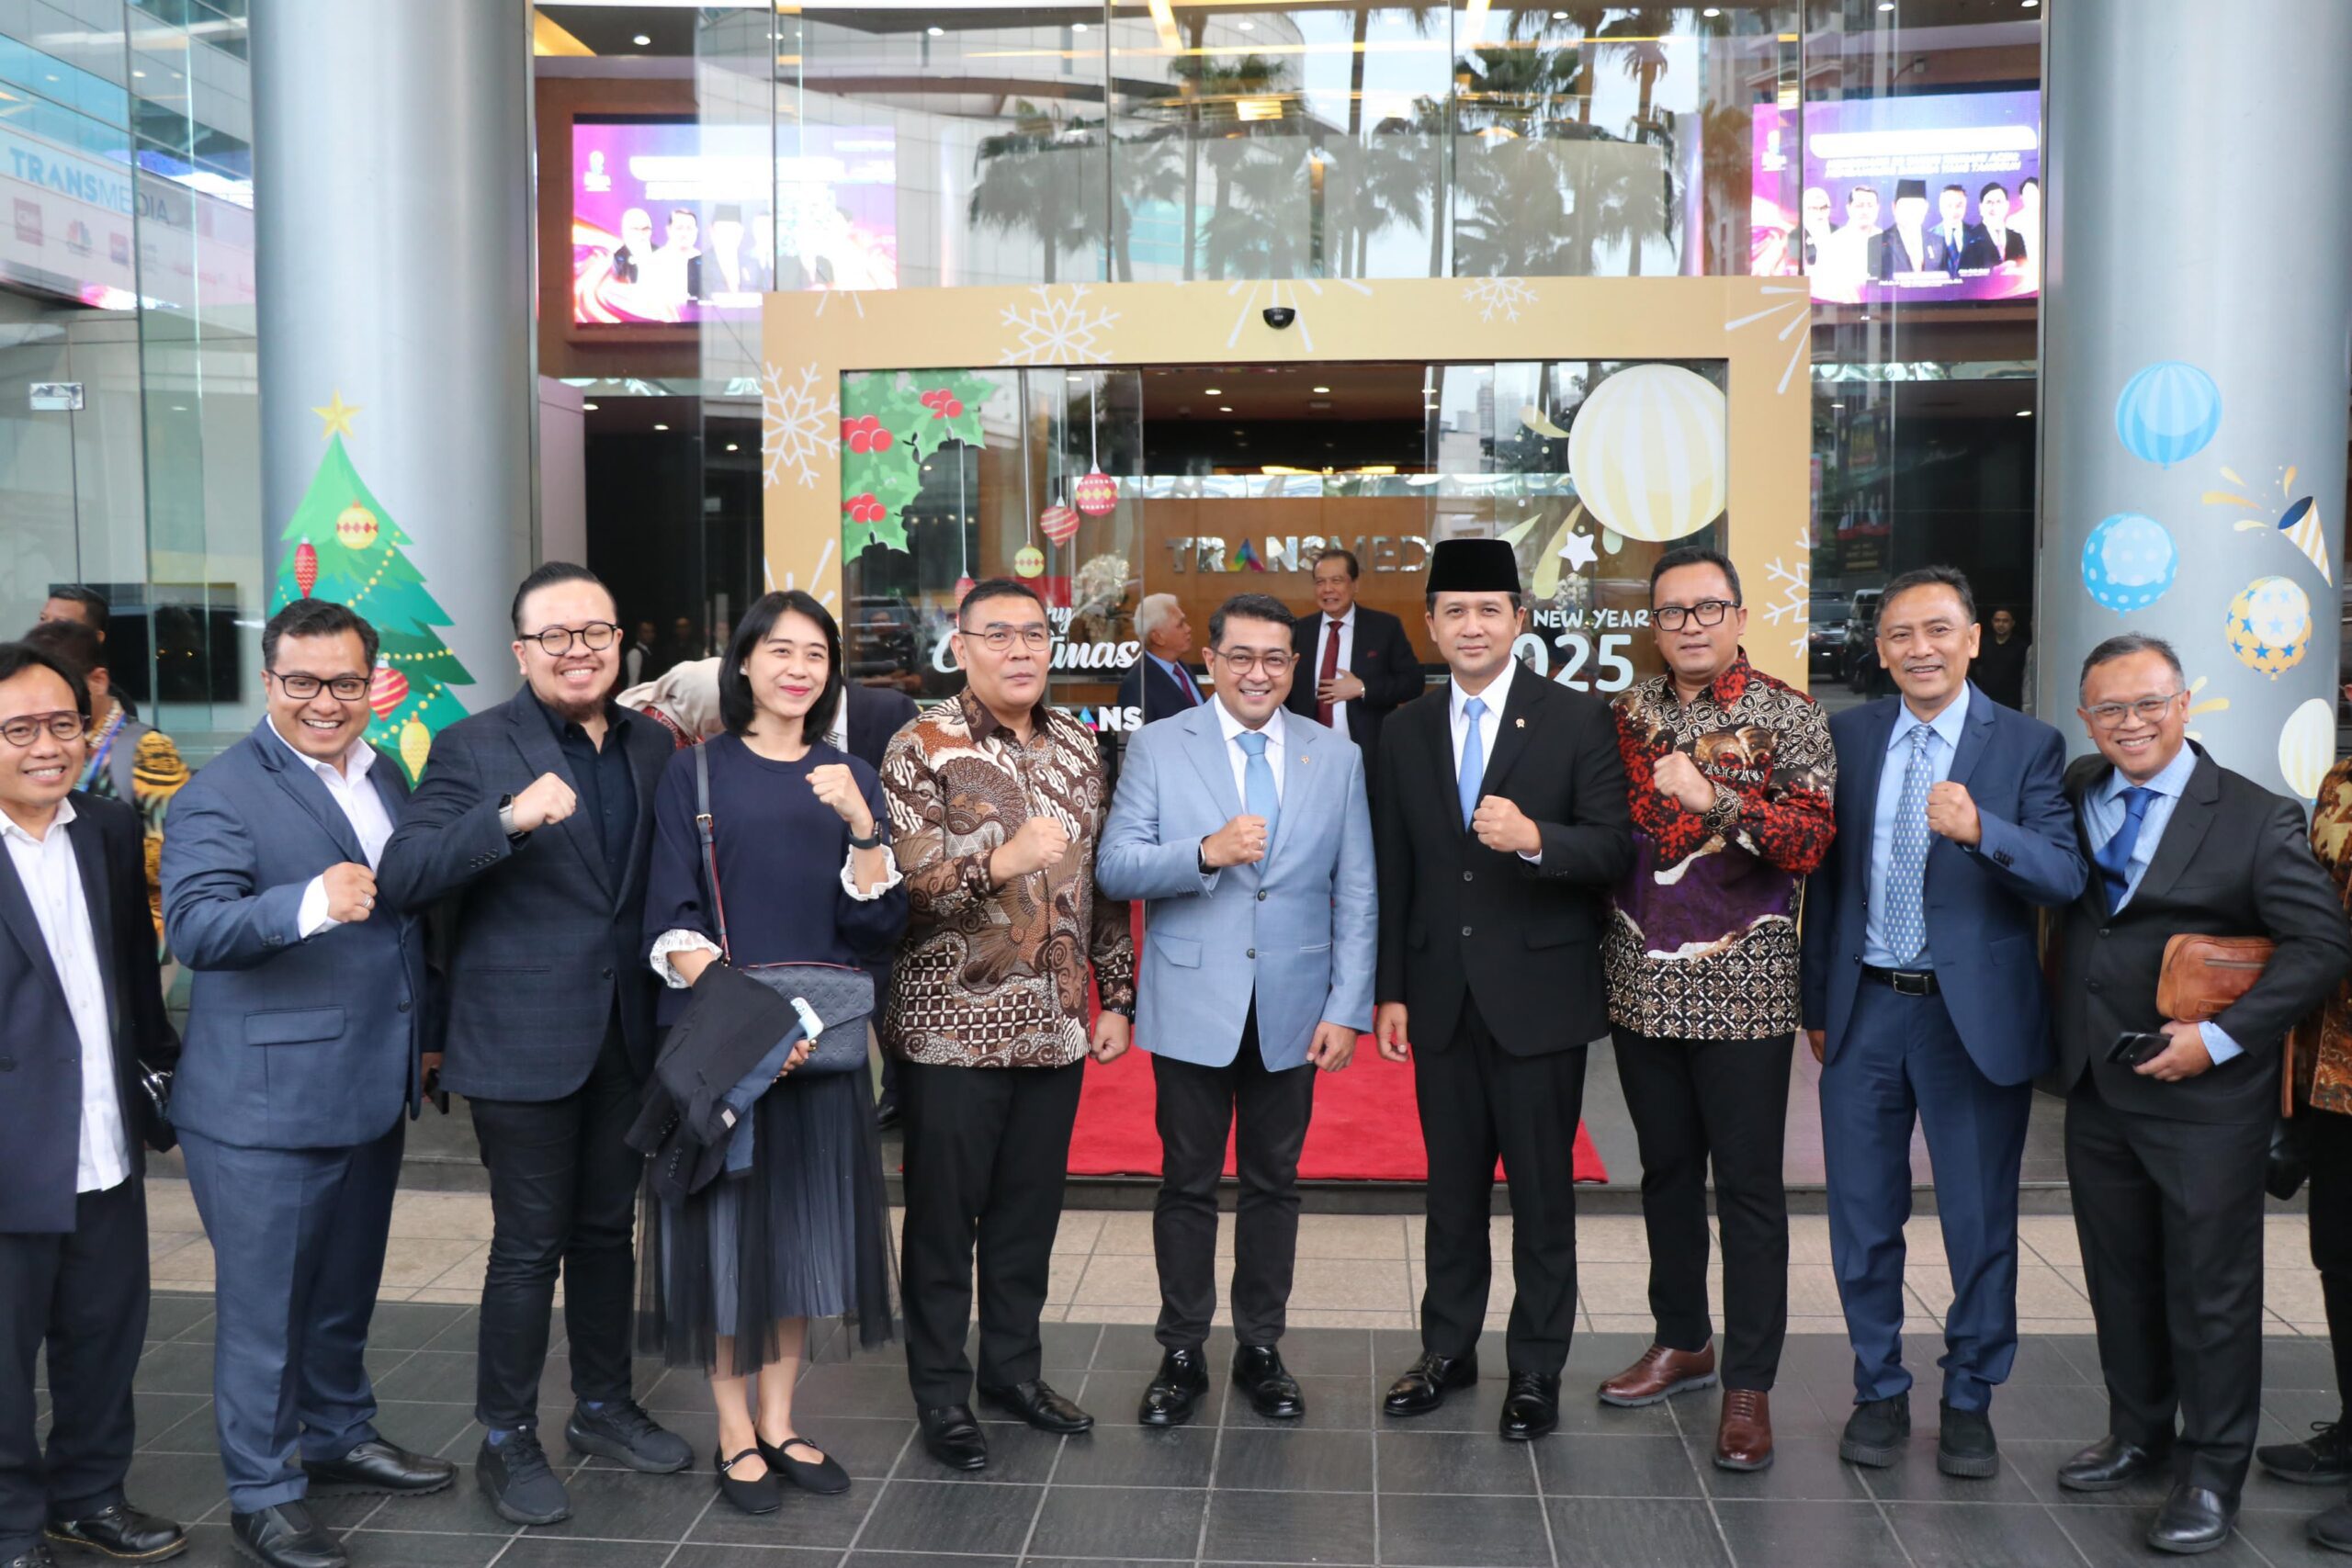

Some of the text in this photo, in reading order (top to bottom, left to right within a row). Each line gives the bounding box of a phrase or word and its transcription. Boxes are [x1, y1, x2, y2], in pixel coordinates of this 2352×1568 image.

[9, 146, 171, 225] TRANSMEDIA
[1165, 536, 1431, 573] TRANSMED
[1533, 608, 1651, 629] NEW YEAR
[1512, 632, 1634, 692] 025
